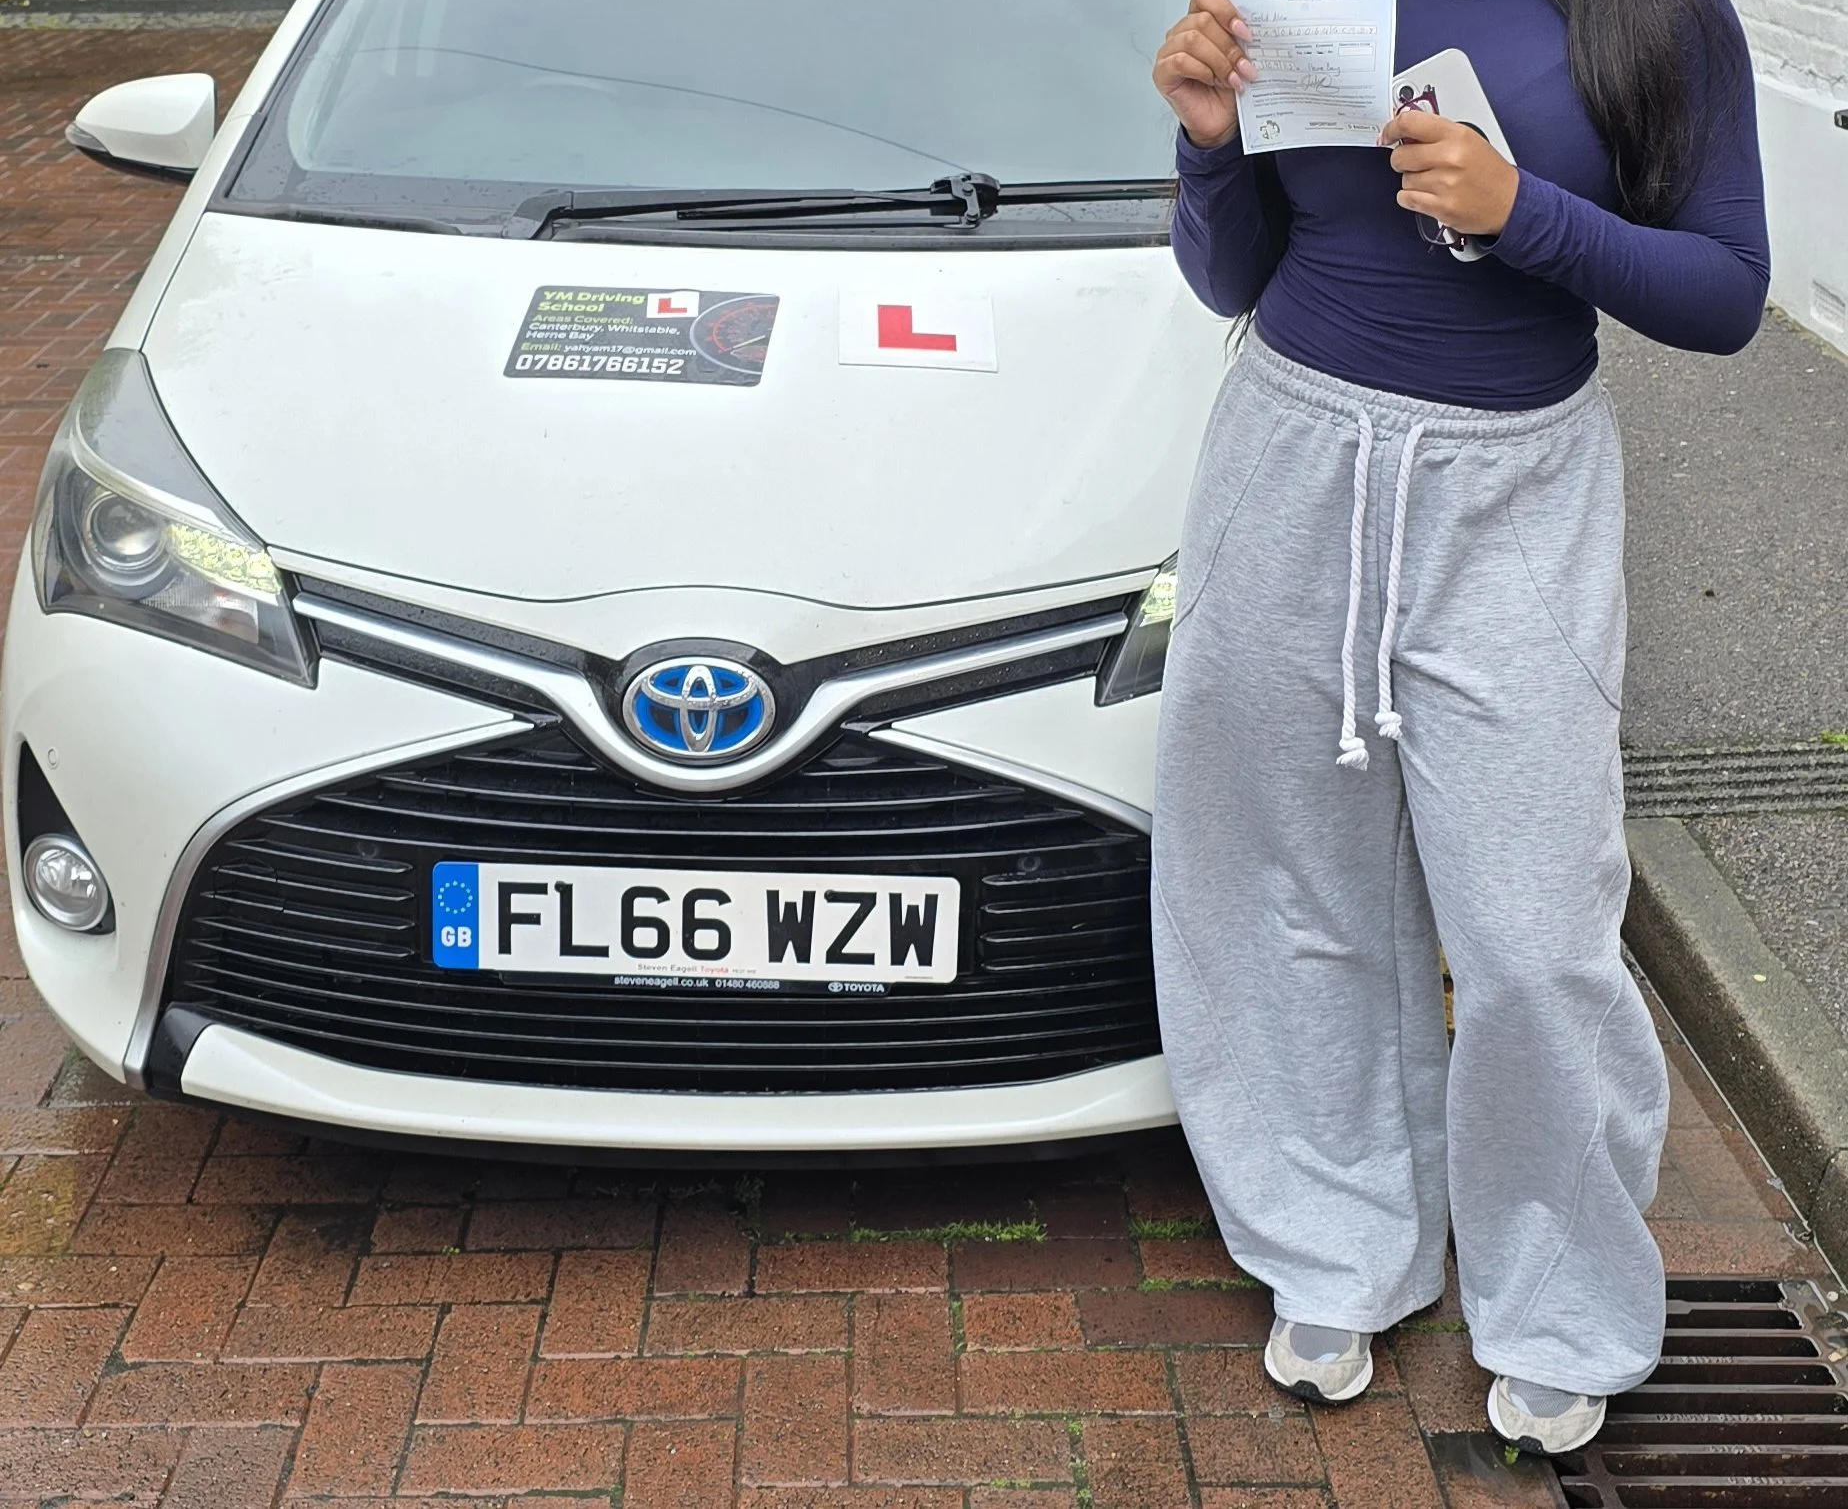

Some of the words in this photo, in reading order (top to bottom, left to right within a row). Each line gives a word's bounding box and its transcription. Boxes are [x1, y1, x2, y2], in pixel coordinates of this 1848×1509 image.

[543, 291, 574, 301] YM
[576, 292, 647, 305] Driving
[537, 301, 605, 313] School
[657, 297, 688, 314] L
[532, 314, 572, 323] Areas
[573, 315, 634, 325] Covered:
[877, 304, 957, 352] L
[525, 330, 567, 339] Herne
[568, 331, 595, 342] Bay
[520, 343, 561, 352] Email:
[515, 354, 685, 375] 07861766152
[498, 880, 732, 962] FL66
[765, 889, 939, 967] WZW
[441, 926, 472, 948] GB
[637, 963, 668, 972] Steven
[670, 964, 698, 974] Eagell
[700, 965, 729, 975] Toyota
[614, 975, 709, 989] steveneagell.co.uk
[715, 978, 744, 989] 01480
[844, 983, 885, 993] TOYOTA
